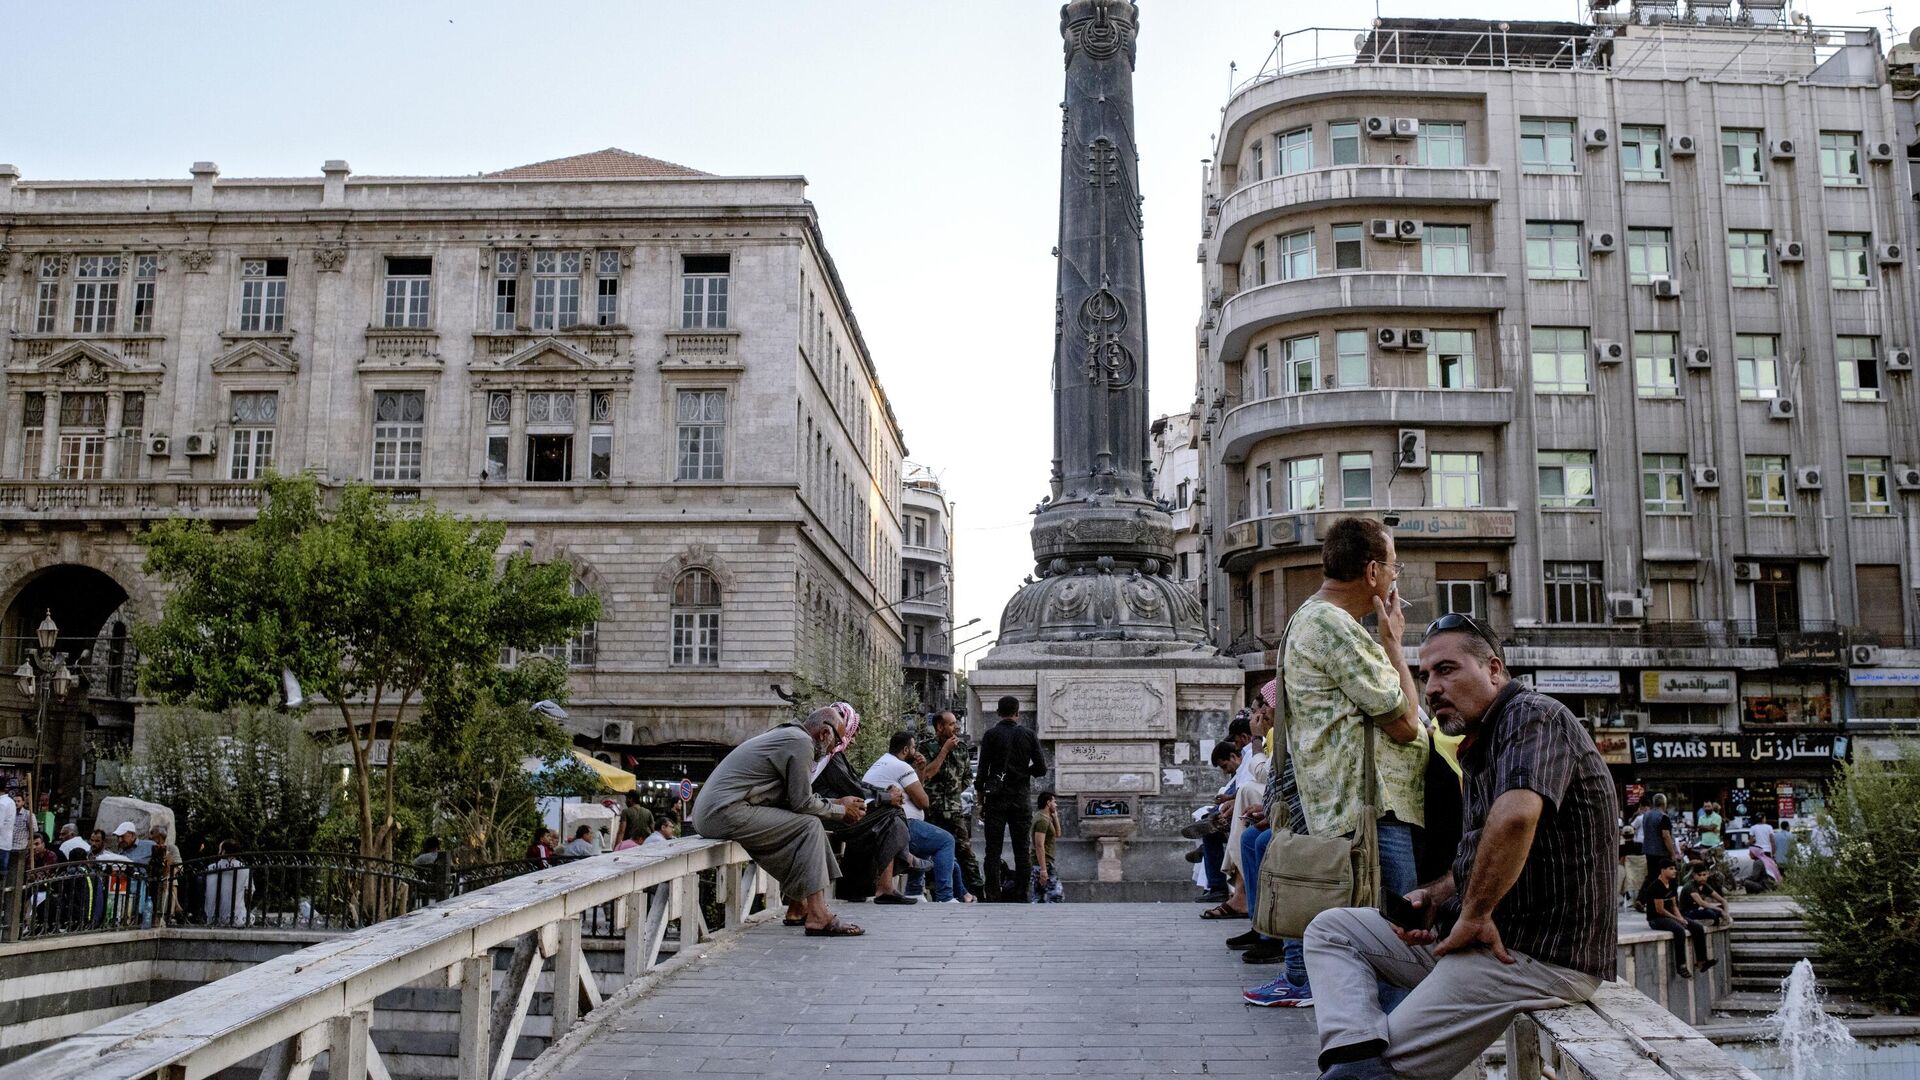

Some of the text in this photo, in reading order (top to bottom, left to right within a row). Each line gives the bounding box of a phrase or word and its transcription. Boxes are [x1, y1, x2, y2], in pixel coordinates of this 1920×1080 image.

[1428, 516, 1467, 533] فندق
[1653, 742, 1741, 758] STARS TEL
[1750, 738, 1830, 760] ستارز تل
